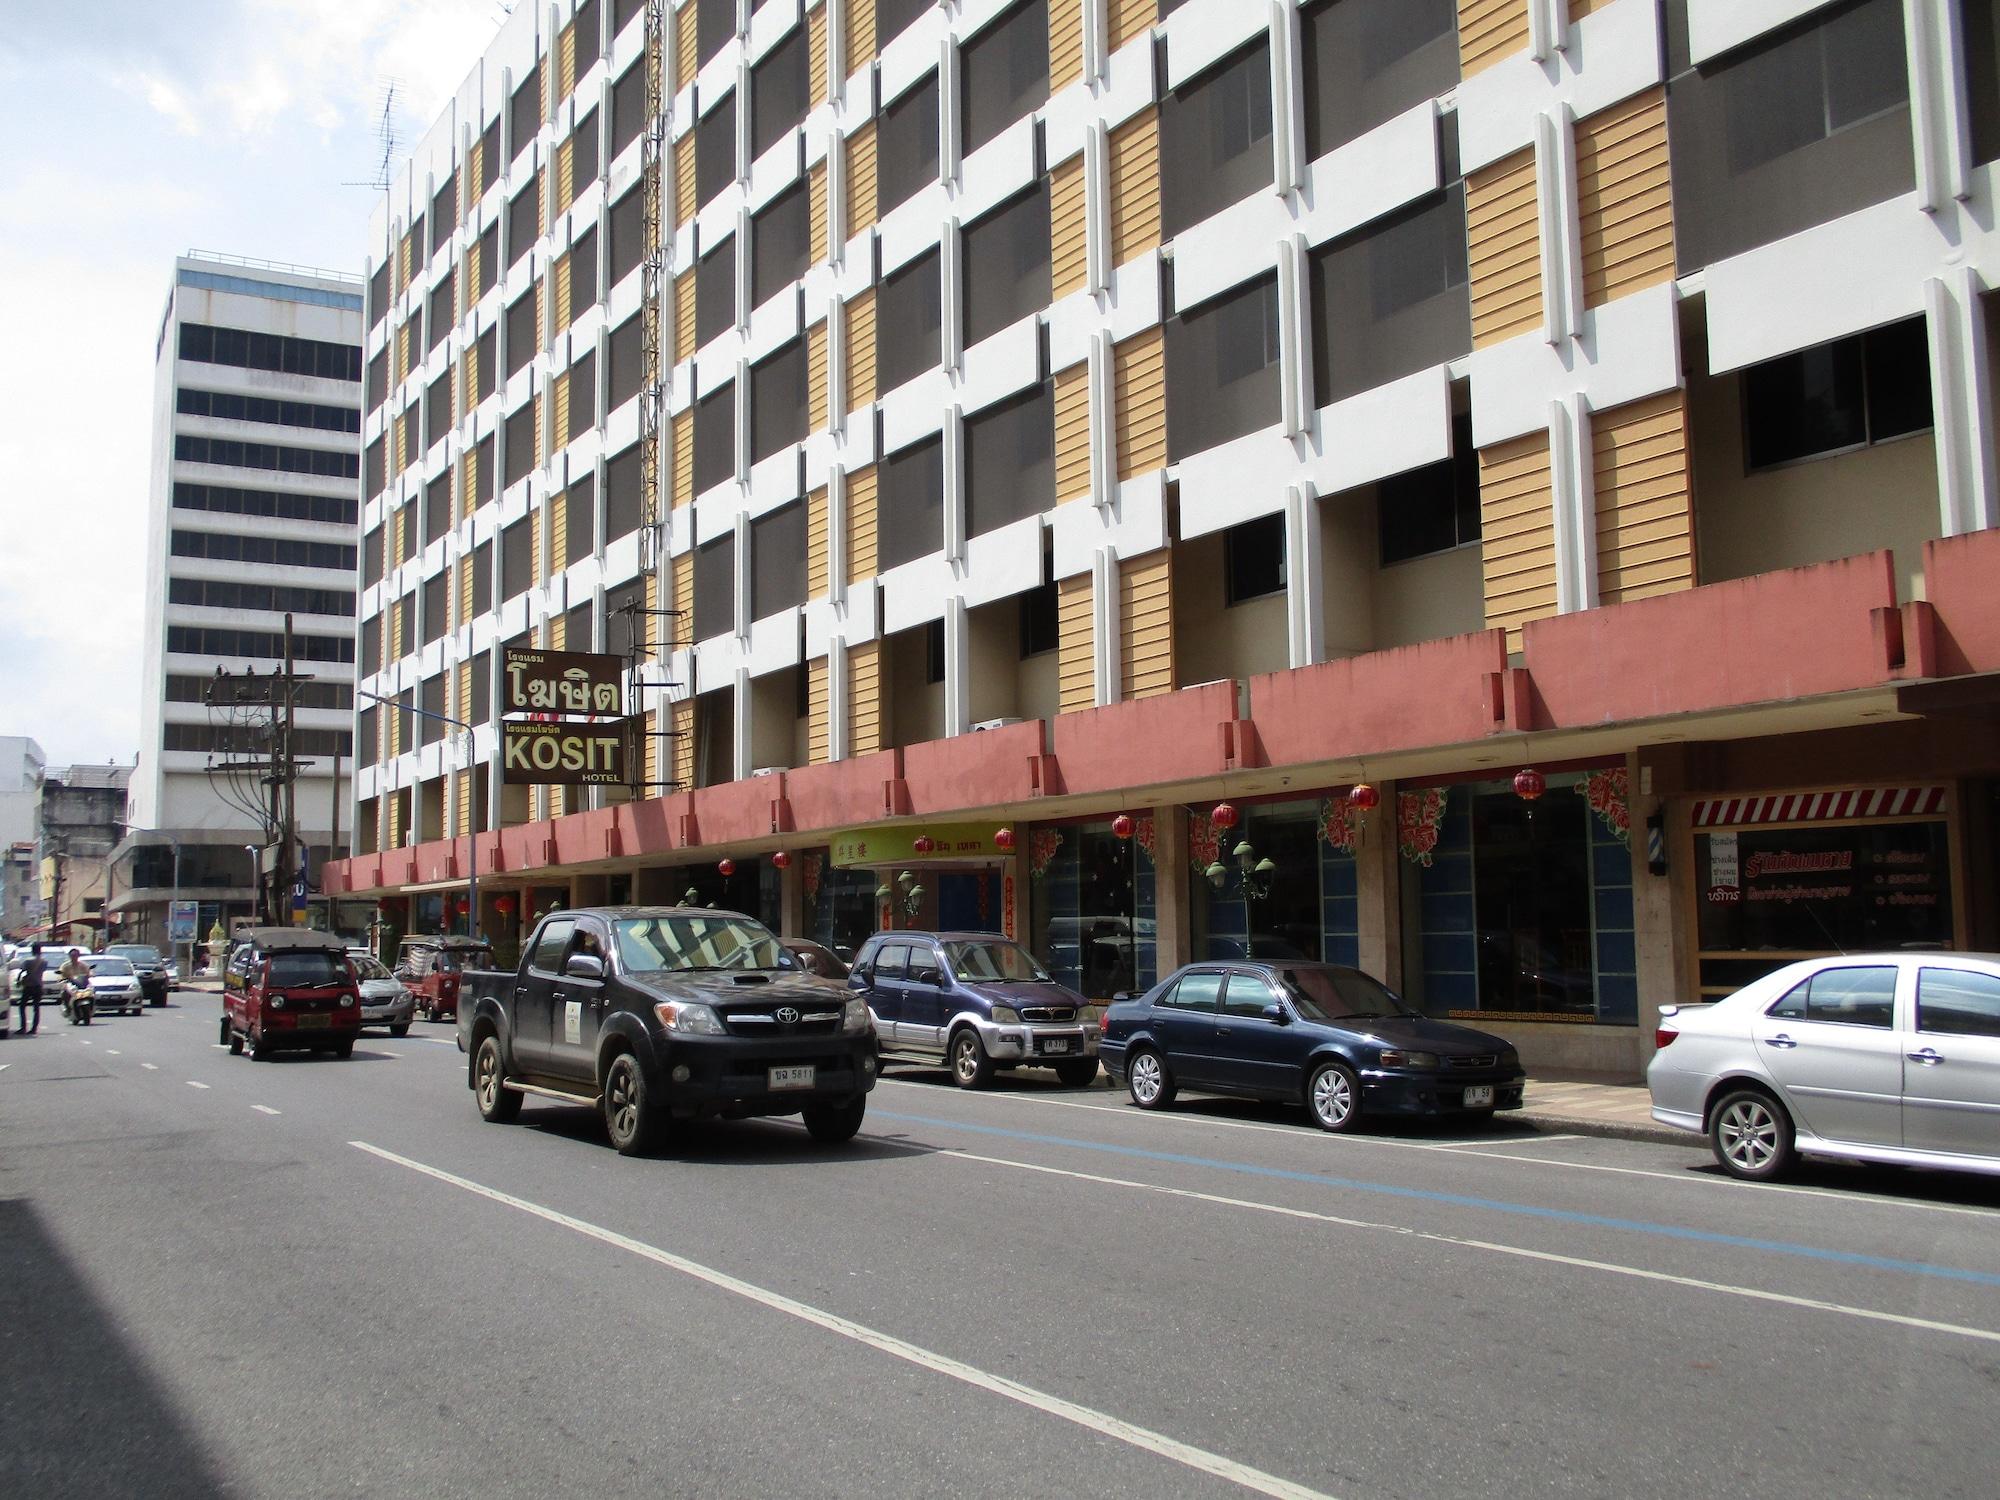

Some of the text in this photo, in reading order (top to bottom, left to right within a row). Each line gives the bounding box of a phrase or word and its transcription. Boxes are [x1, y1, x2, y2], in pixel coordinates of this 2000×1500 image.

[507, 650, 544, 663] โรงแรม
[506, 661, 619, 712] โฆษิต
[505, 735, 621, 771] KOSIT
[582, 773, 621, 782] HOTEL
[792, 1069, 812, 1079] 5811
